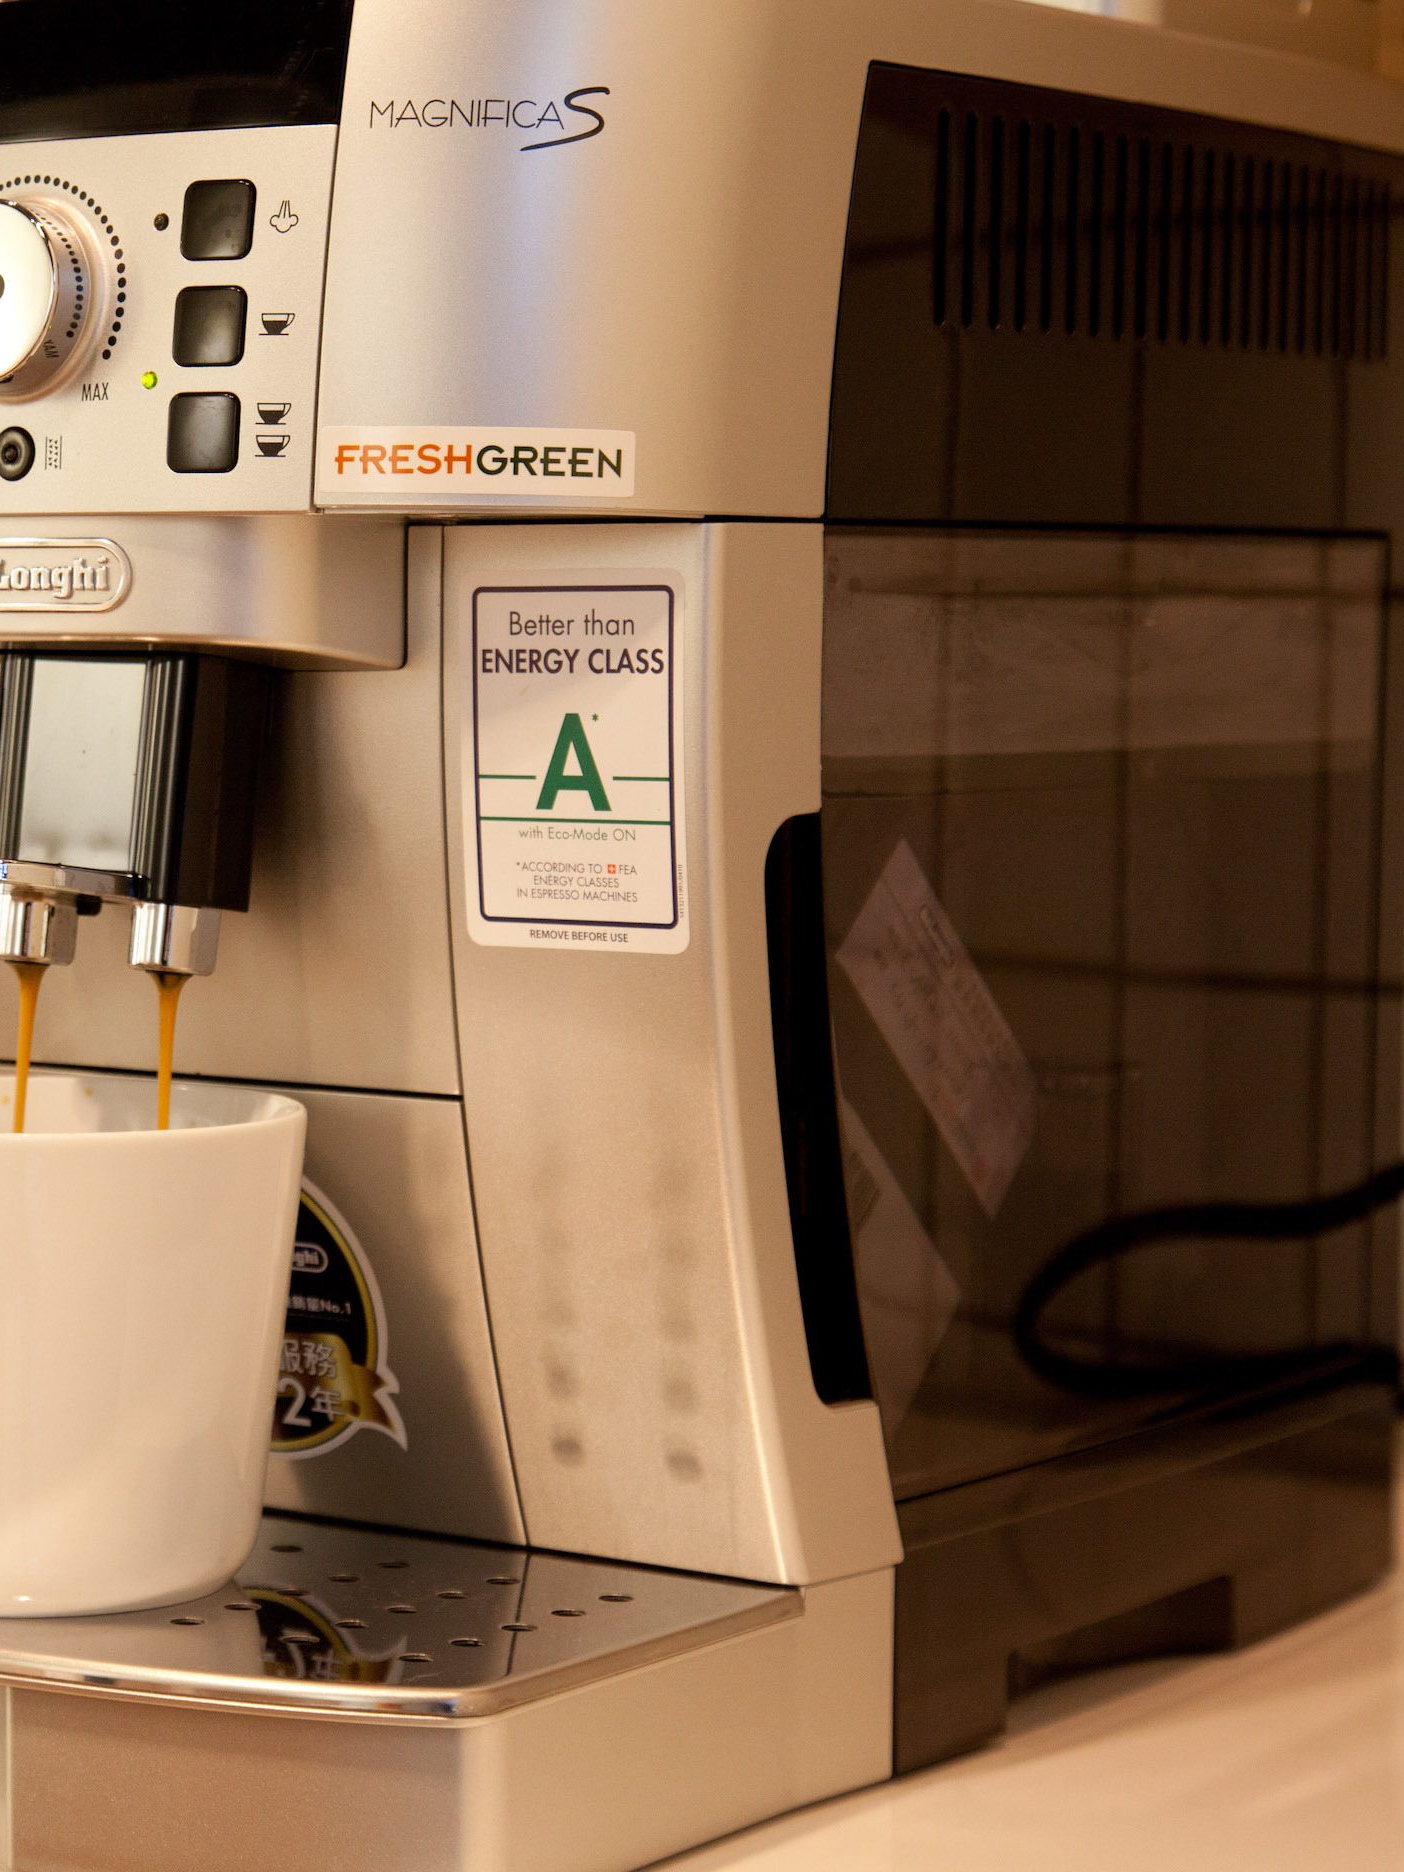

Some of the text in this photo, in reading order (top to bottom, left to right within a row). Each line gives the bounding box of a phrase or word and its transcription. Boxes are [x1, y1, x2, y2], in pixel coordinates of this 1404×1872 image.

[81, 382, 109, 402] MAX
[334, 444, 623, 479] FRESHGREEN
[509, 608, 635, 636] Better than
[481, 648, 665, 674] ENERGY CLASS
[518, 826, 636, 842] with Eco-Mode ON
[588, 863, 602, 875] TO
[618, 864, 638, 876] FEA
[533, 875, 620, 889] ENERGY CLASSES
[517, 888, 638, 903] IN ESPRESSO MACHINES
[529, 929, 629, 943] REMOVE BEFORE USE
